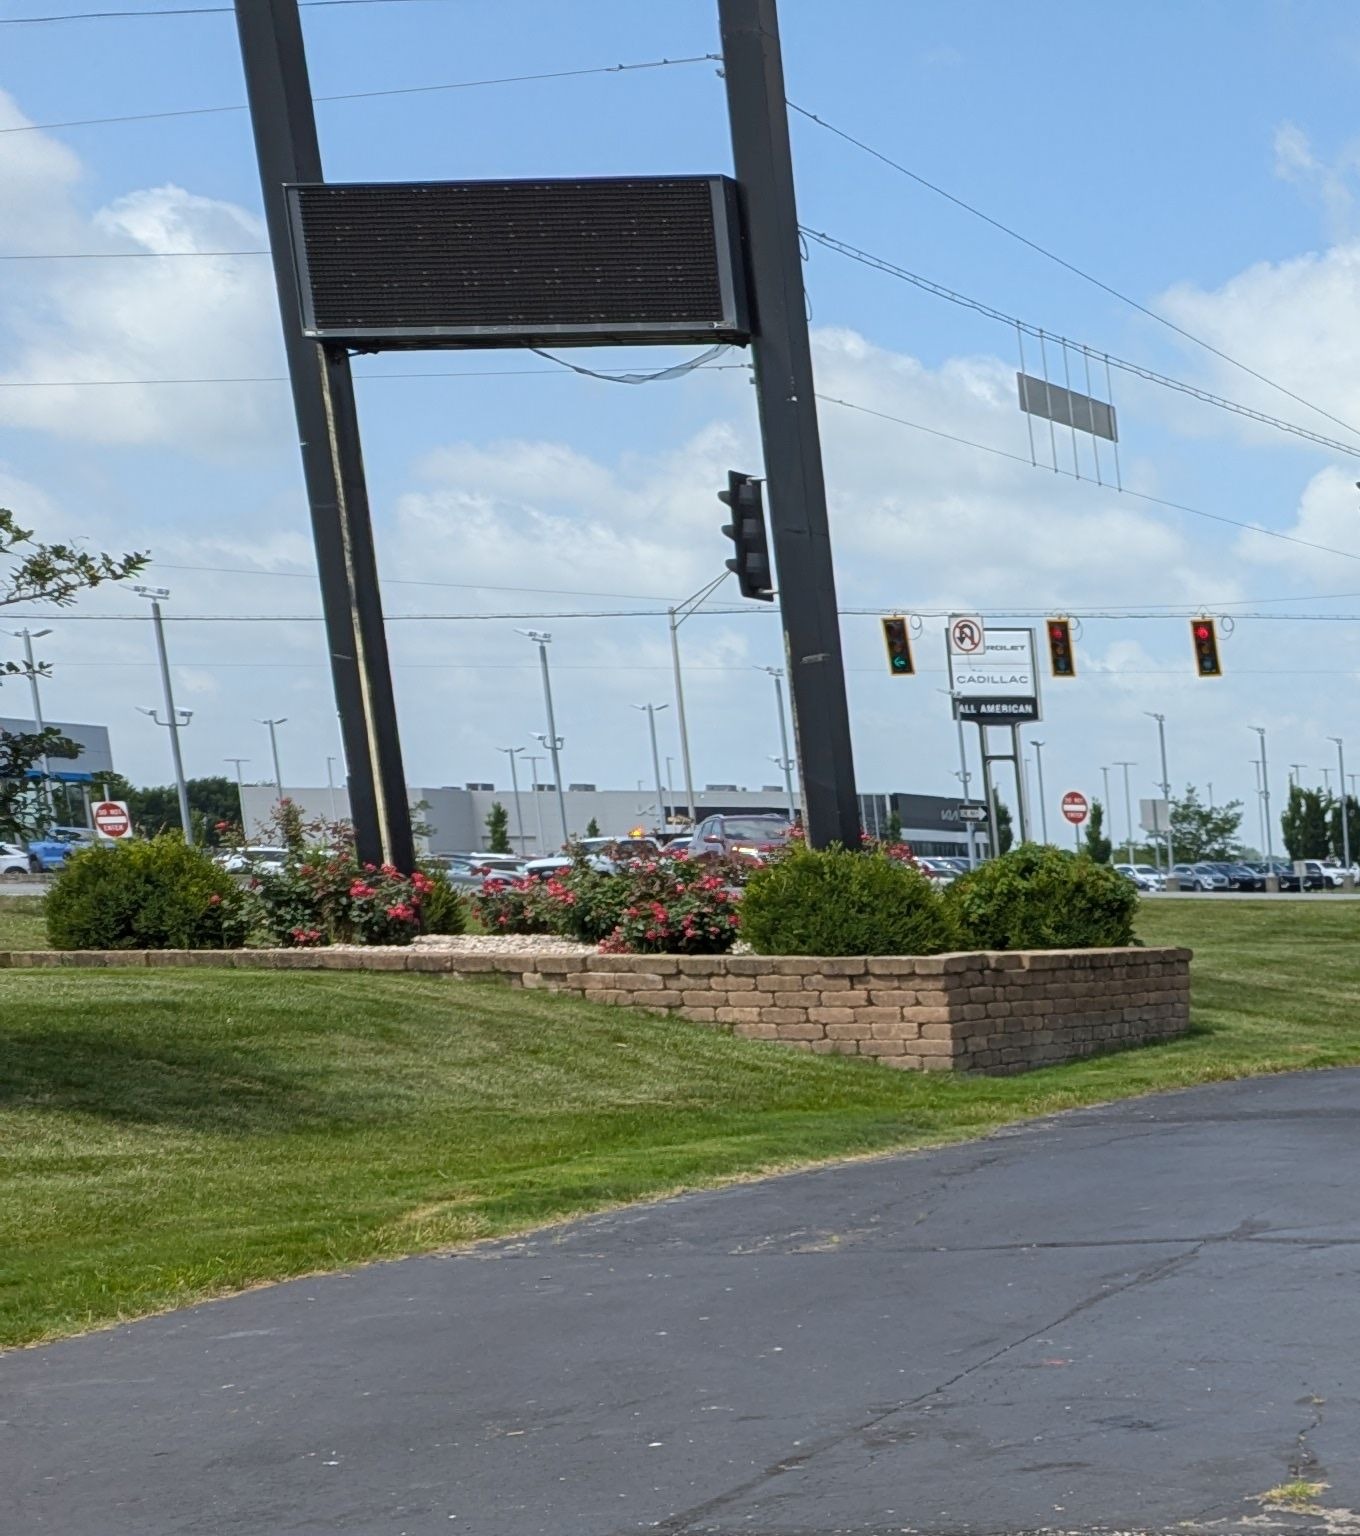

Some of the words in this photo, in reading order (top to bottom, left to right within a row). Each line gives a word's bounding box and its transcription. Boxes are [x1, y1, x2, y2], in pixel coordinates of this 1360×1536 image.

[956, 675, 1029, 684] CADILLAC
[959, 704, 977, 714] ALL
[980, 704, 1033, 714] AMERICAN
